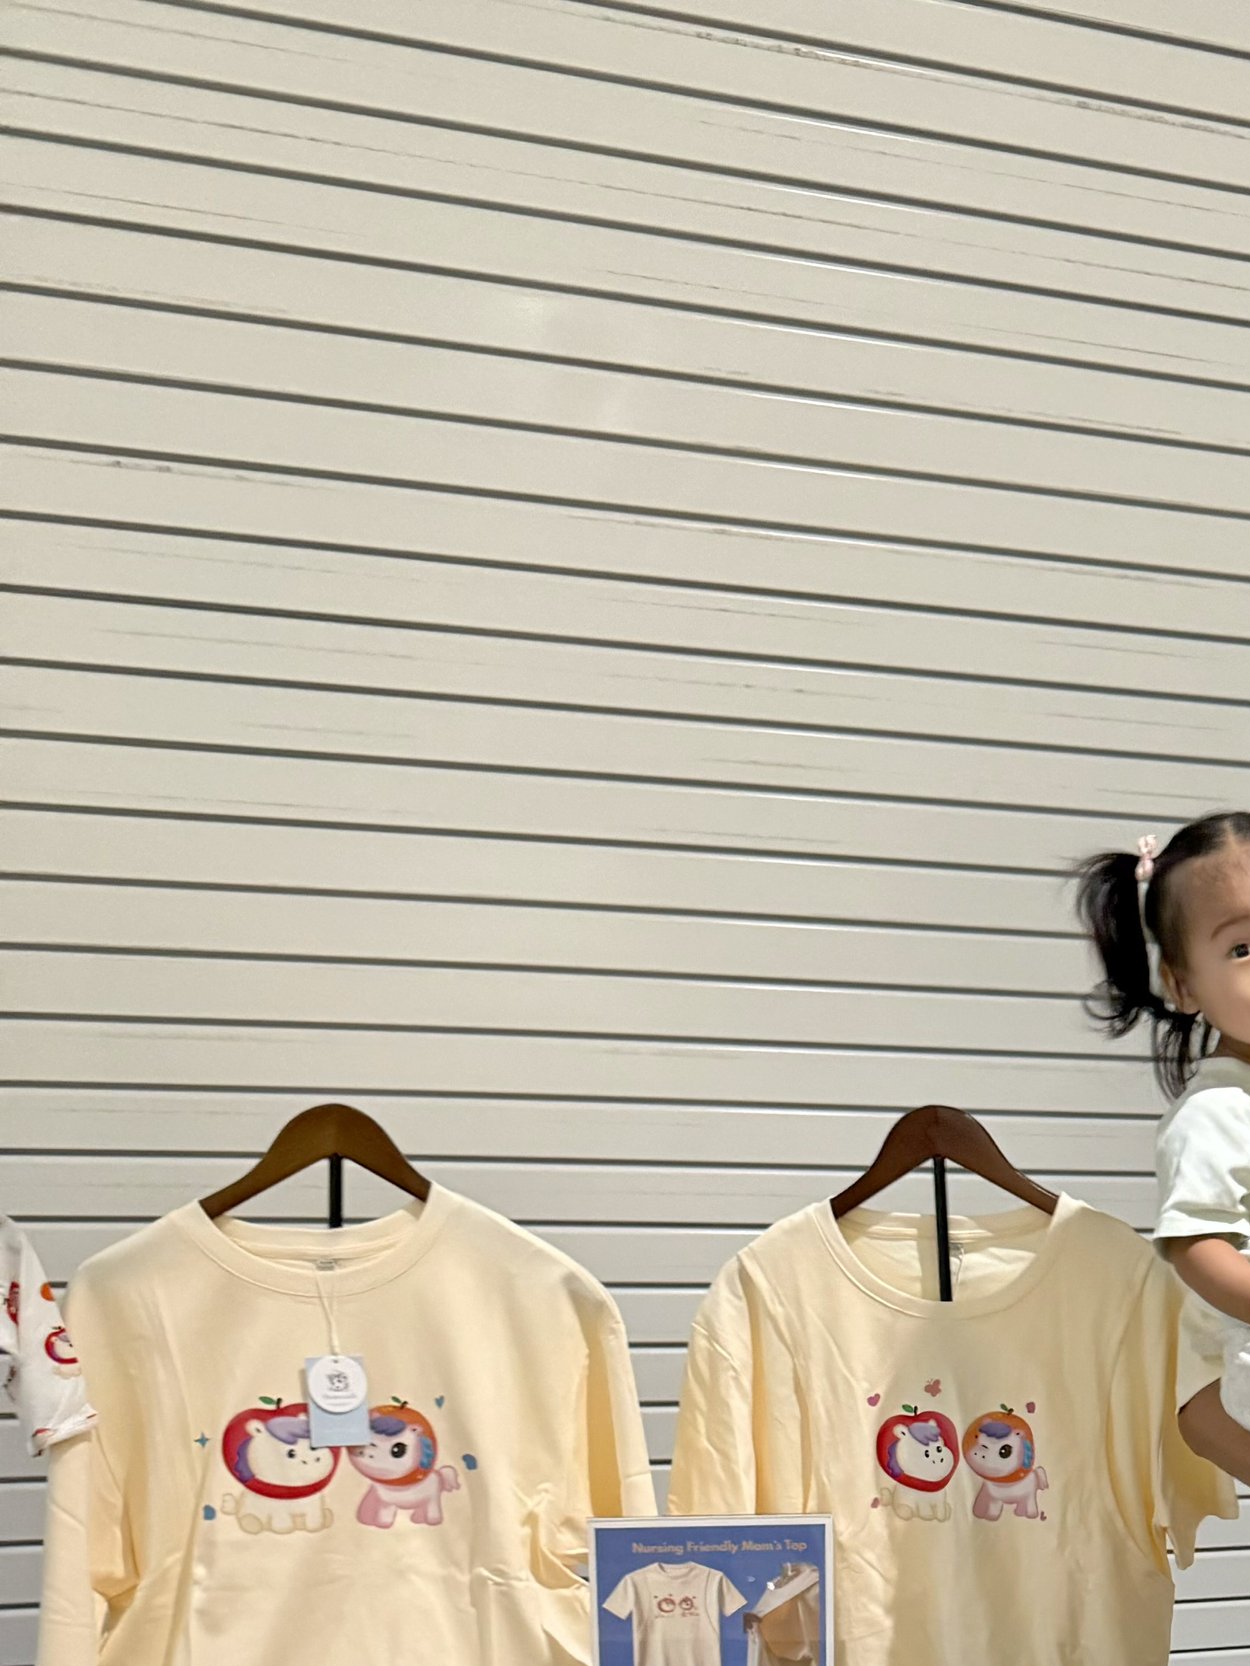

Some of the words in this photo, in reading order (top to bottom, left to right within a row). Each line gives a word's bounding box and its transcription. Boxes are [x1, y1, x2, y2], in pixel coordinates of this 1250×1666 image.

[632, 1542, 684, 1555] Nursing
[686, 1540, 738, 1555] Friendly
[783, 1539, 808, 1552] Top
